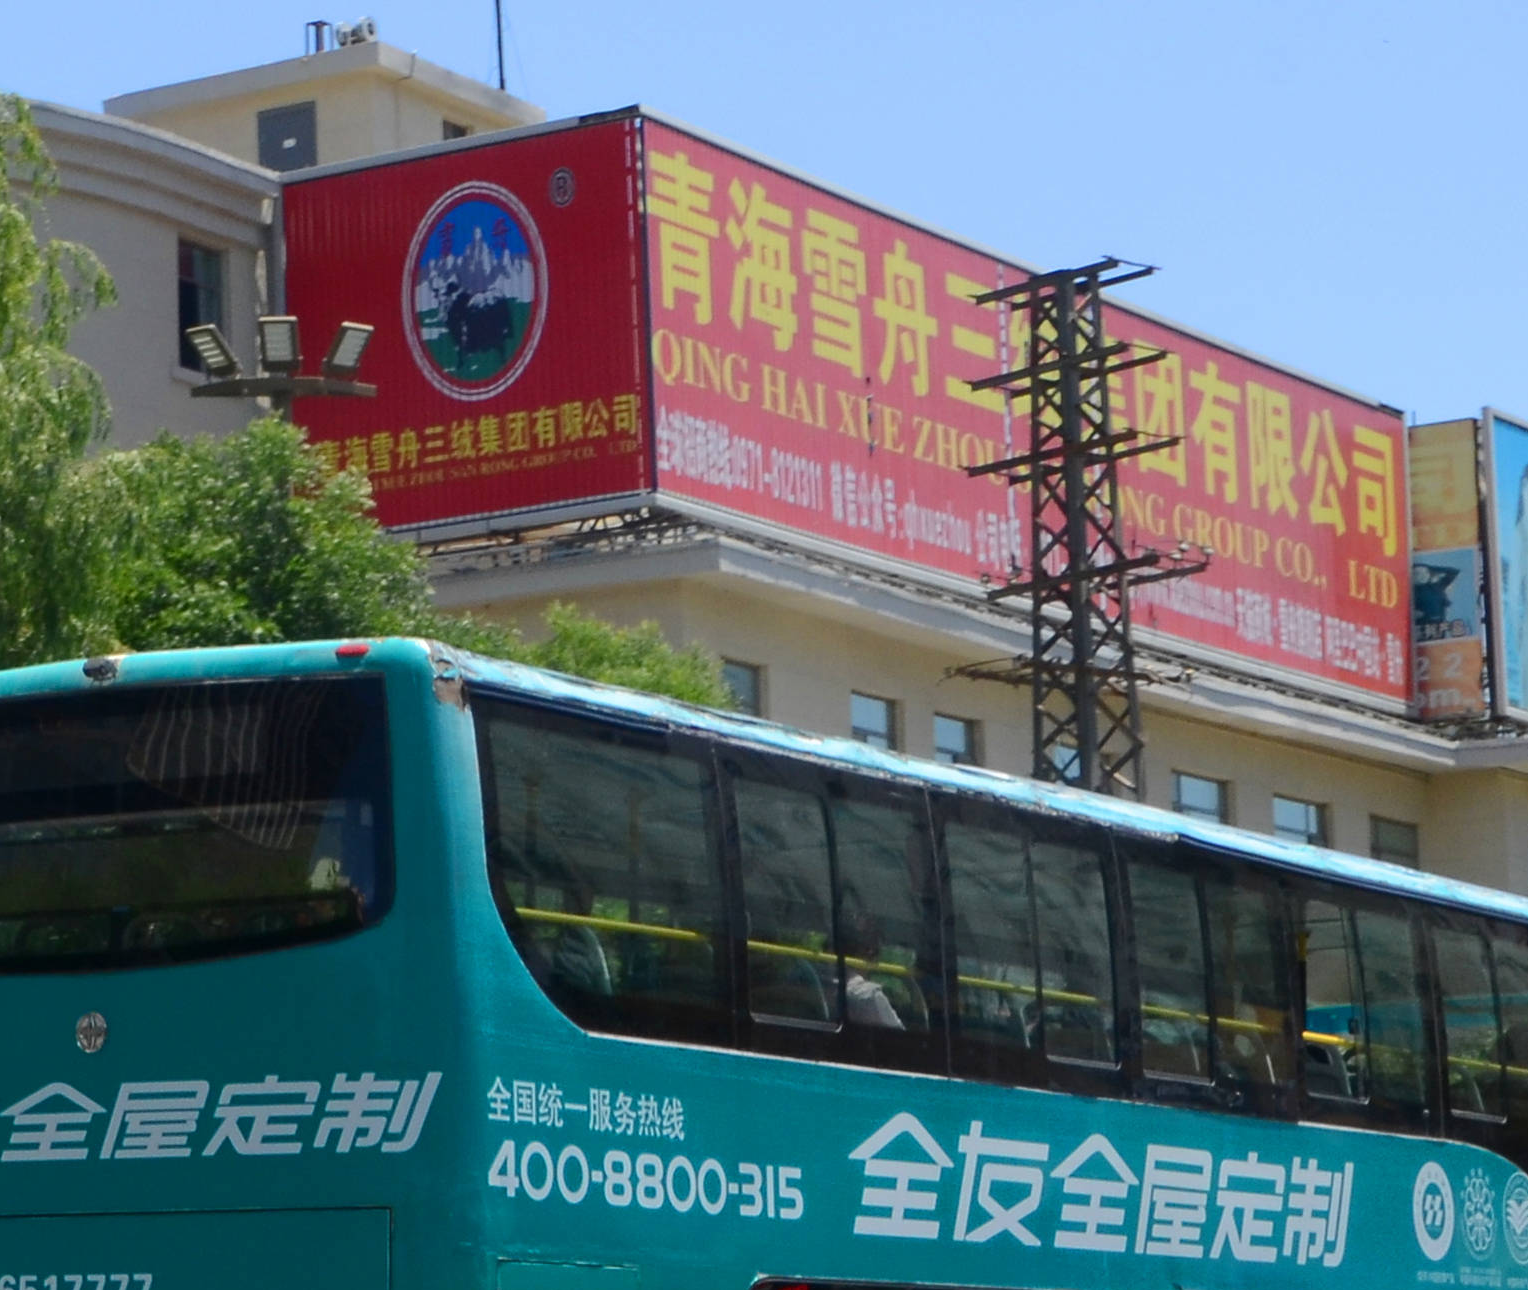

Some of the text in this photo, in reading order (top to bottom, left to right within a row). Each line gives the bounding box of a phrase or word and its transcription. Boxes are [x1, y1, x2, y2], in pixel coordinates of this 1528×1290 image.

[652, 329, 750, 402] QING
[761, 363, 827, 430] HAI
[839, 390, 905, 454] XUE
[1173, 504, 1268, 568] GROUP
[1349, 560, 1399, 609] LTD
[487, 1076, 685, 1141] 全国统一服务热线
[487, 1140, 804, 1220] 400-8800-315
[848, 1112, 1354, 1268] 全友全屋定制
